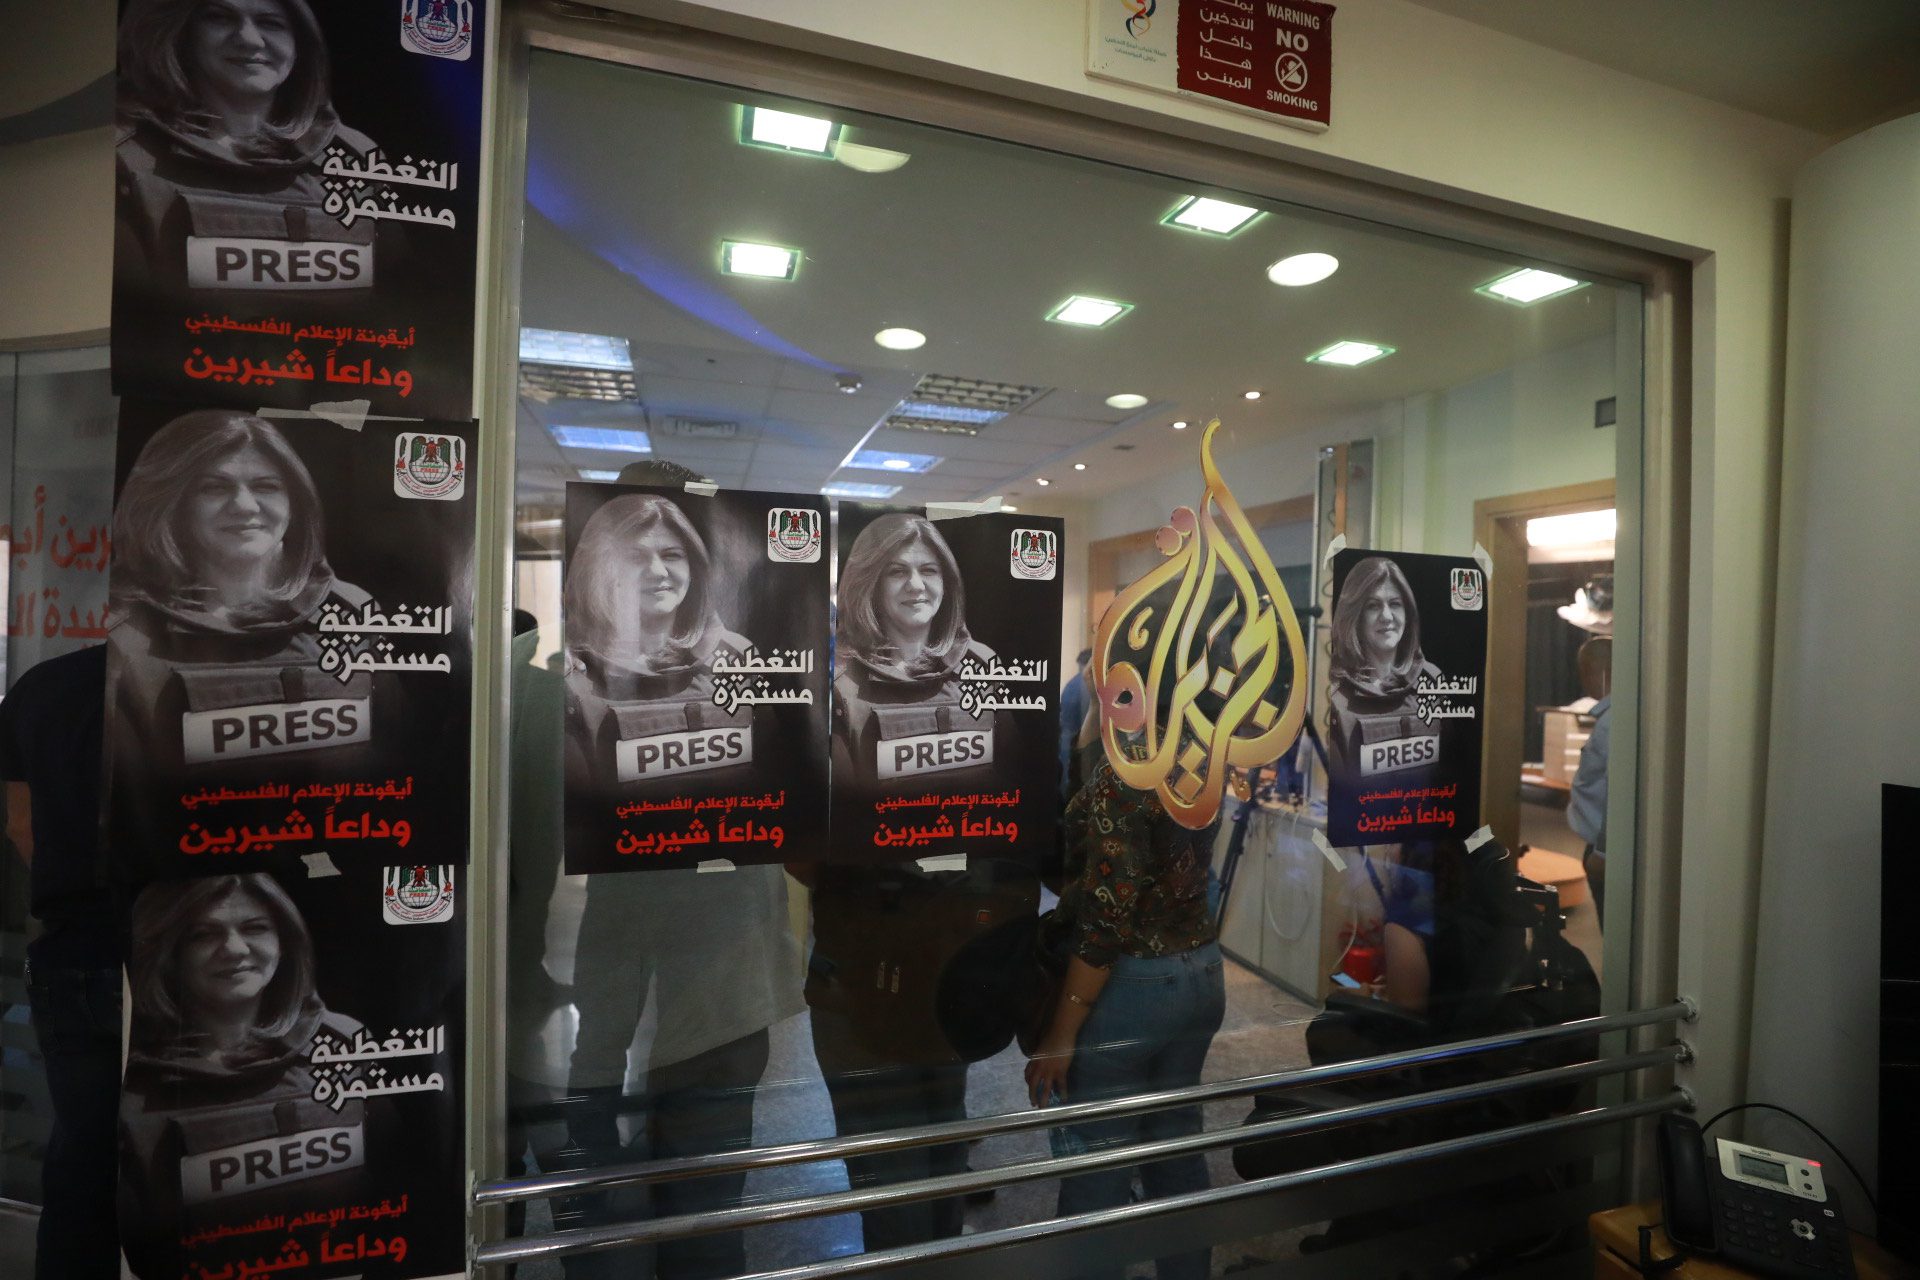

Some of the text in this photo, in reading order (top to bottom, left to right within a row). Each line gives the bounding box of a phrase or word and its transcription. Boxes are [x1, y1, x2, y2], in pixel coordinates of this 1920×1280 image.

[1200, 8, 1253, 31] التدخين
[1267, 2, 1320, 30] WARNING
[1200, 28, 1252, 50] داخل
[1276, 28, 1309, 52] NO
[1200, 45, 1251, 70] هذا
[1197, 71, 1251, 90] المبنى
[1266, 90, 1318, 111] SMOKING
[323, 145, 458, 191] التغطية
[325, 181, 456, 230] مستمرة
[214, 247, 361, 283] PRESS
[185, 314, 416, 349] أيقونة الإعلام الفلسطيني
[184, 348, 315, 386] شيرين
[51, 514, 111, 573] رين
[319, 603, 451, 643] التغطية
[321, 638, 450, 682] مستمرة
[712, 649, 814, 684] التغطية
[960, 658, 1048, 693] التغطية
[713, 681, 813, 716] مستمرة
[961, 688, 1046, 719] مستمرة
[1416, 673, 1476, 703] التغطية
[212, 705, 358, 753] PRESS
[636, 732, 744, 774] PRESS
[893, 735, 986, 772] PRESS
[1371, 740, 1435, 770] PRESS
[181, 776, 413, 809] أيقونة الإعلام الفلسطيني
[616, 790, 785, 819] أيقونة الإعلام الفلسطيني
[875, 789, 1021, 814] أيقونة الإعلام الفلسطيني
[1359, 783, 1457, 805] أيقونة الإعلام الفلسطيني
[180, 810, 315, 855] شيرين
[873, 815, 955, 847] شيرين
[1358, 806, 1413, 832] شيرين
[616, 820, 711, 855] شيرين
[311, 1025, 444, 1071] التغطية
[314, 1067, 444, 1112] مستمرة
[209, 1132, 352, 1193] PRESS
[288, 1208, 346, 1233] الإعلام
[348, 1193, 408, 1220] أيقونة
